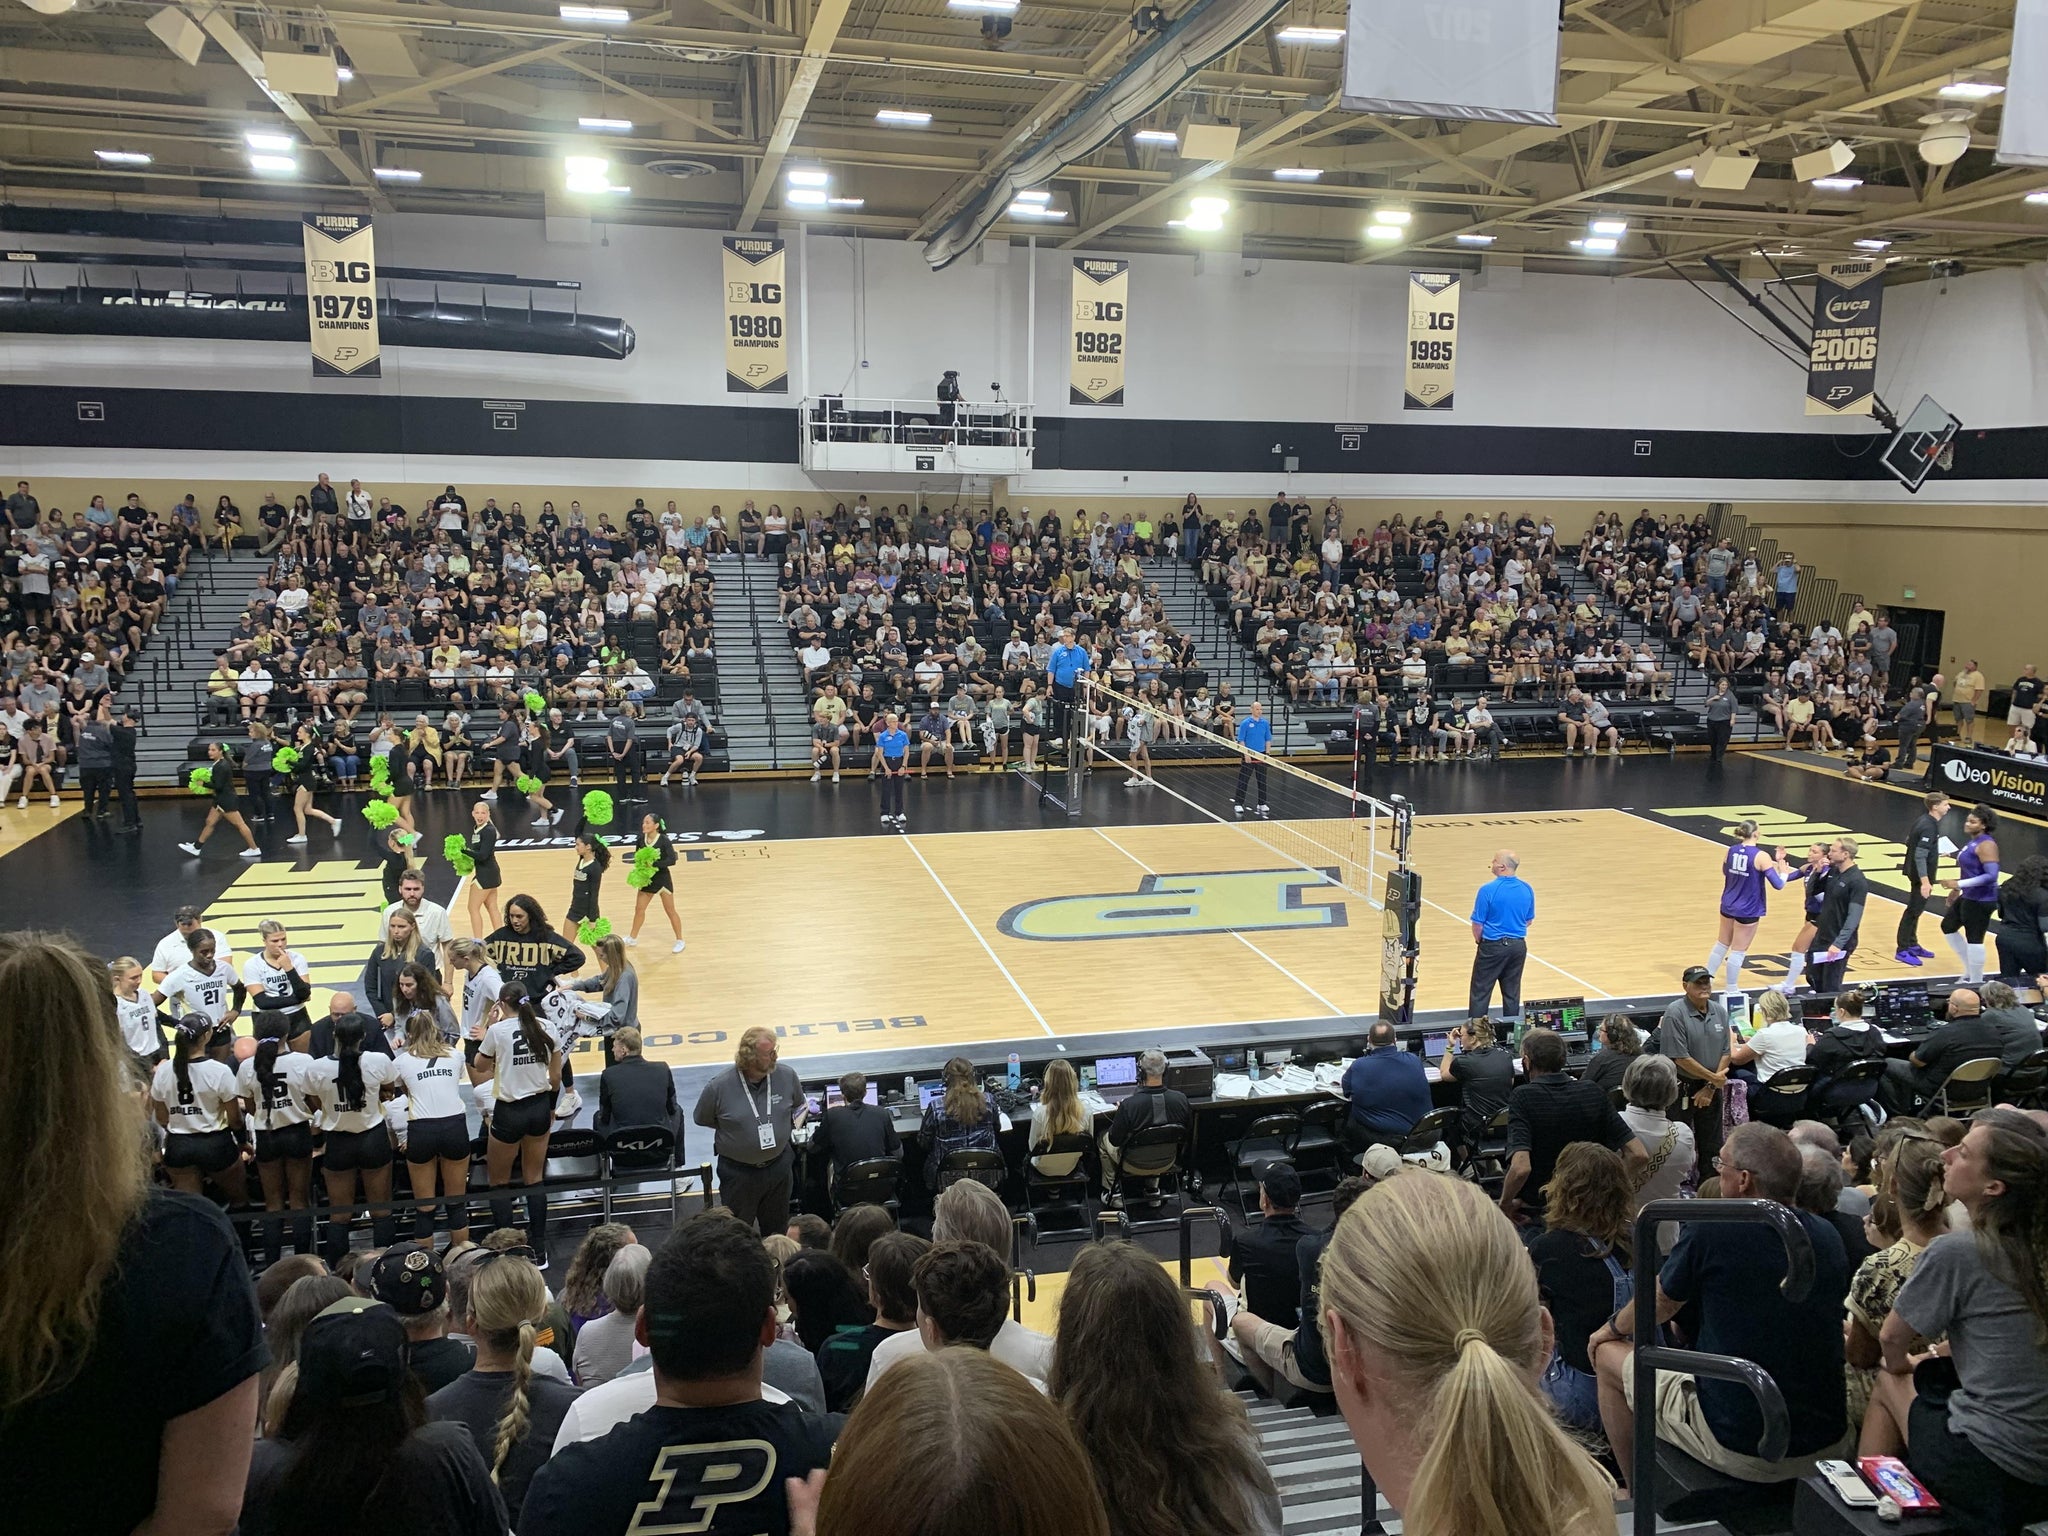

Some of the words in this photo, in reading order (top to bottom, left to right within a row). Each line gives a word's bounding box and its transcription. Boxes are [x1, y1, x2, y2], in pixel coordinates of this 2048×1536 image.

[316, 215, 358, 228] PURDUE
[735, 239, 773, 252] PURDUE
[1084, 260, 1118, 272] PURDUE
[1831, 262, 1872, 275] PURDUE
[1420, 273, 1451, 284] PURDUE
[313, 295, 373, 319] 1979
[1832, 299, 1871, 312] avca
[319, 320, 369, 330] CHAMPIONS
[729, 315, 782, 338] 1980
[1815, 328, 1842, 338] CAROL
[1845, 326, 1876, 336] DEWEY
[733, 339, 779, 348] CHAMPIONS
[1075, 331, 1122, 355] 1982
[1811, 336, 1878, 362] 2006
[1410, 341, 1453, 361] 1985
[1078, 355, 1118, 364] CHAMPIONS
[1412, 362, 1449, 370] CHAMPIONS
[1812, 362, 1833, 372] HALL
[1835, 361, 1846, 370] OF
[1848, 360, 1873, 370] FAME
[1955, 762, 2046, 796] NeoVision
[2029, 796, 2044, 806] P.C.
[1732, 853, 1748, 871] 10
[1387, 888, 1400, 901] P
[195, 980, 224, 993] PURDUE
[277, 983, 289, 996] 2
[203, 989, 220, 1006] 21
[129, 1006, 150, 1018] PURDUE
[141, 1016, 149, 1030] 6
[417, 1068, 453, 1081] BOILERS
[273, 1073, 288, 1098] 5
[625, 1439, 777, 1536] P
